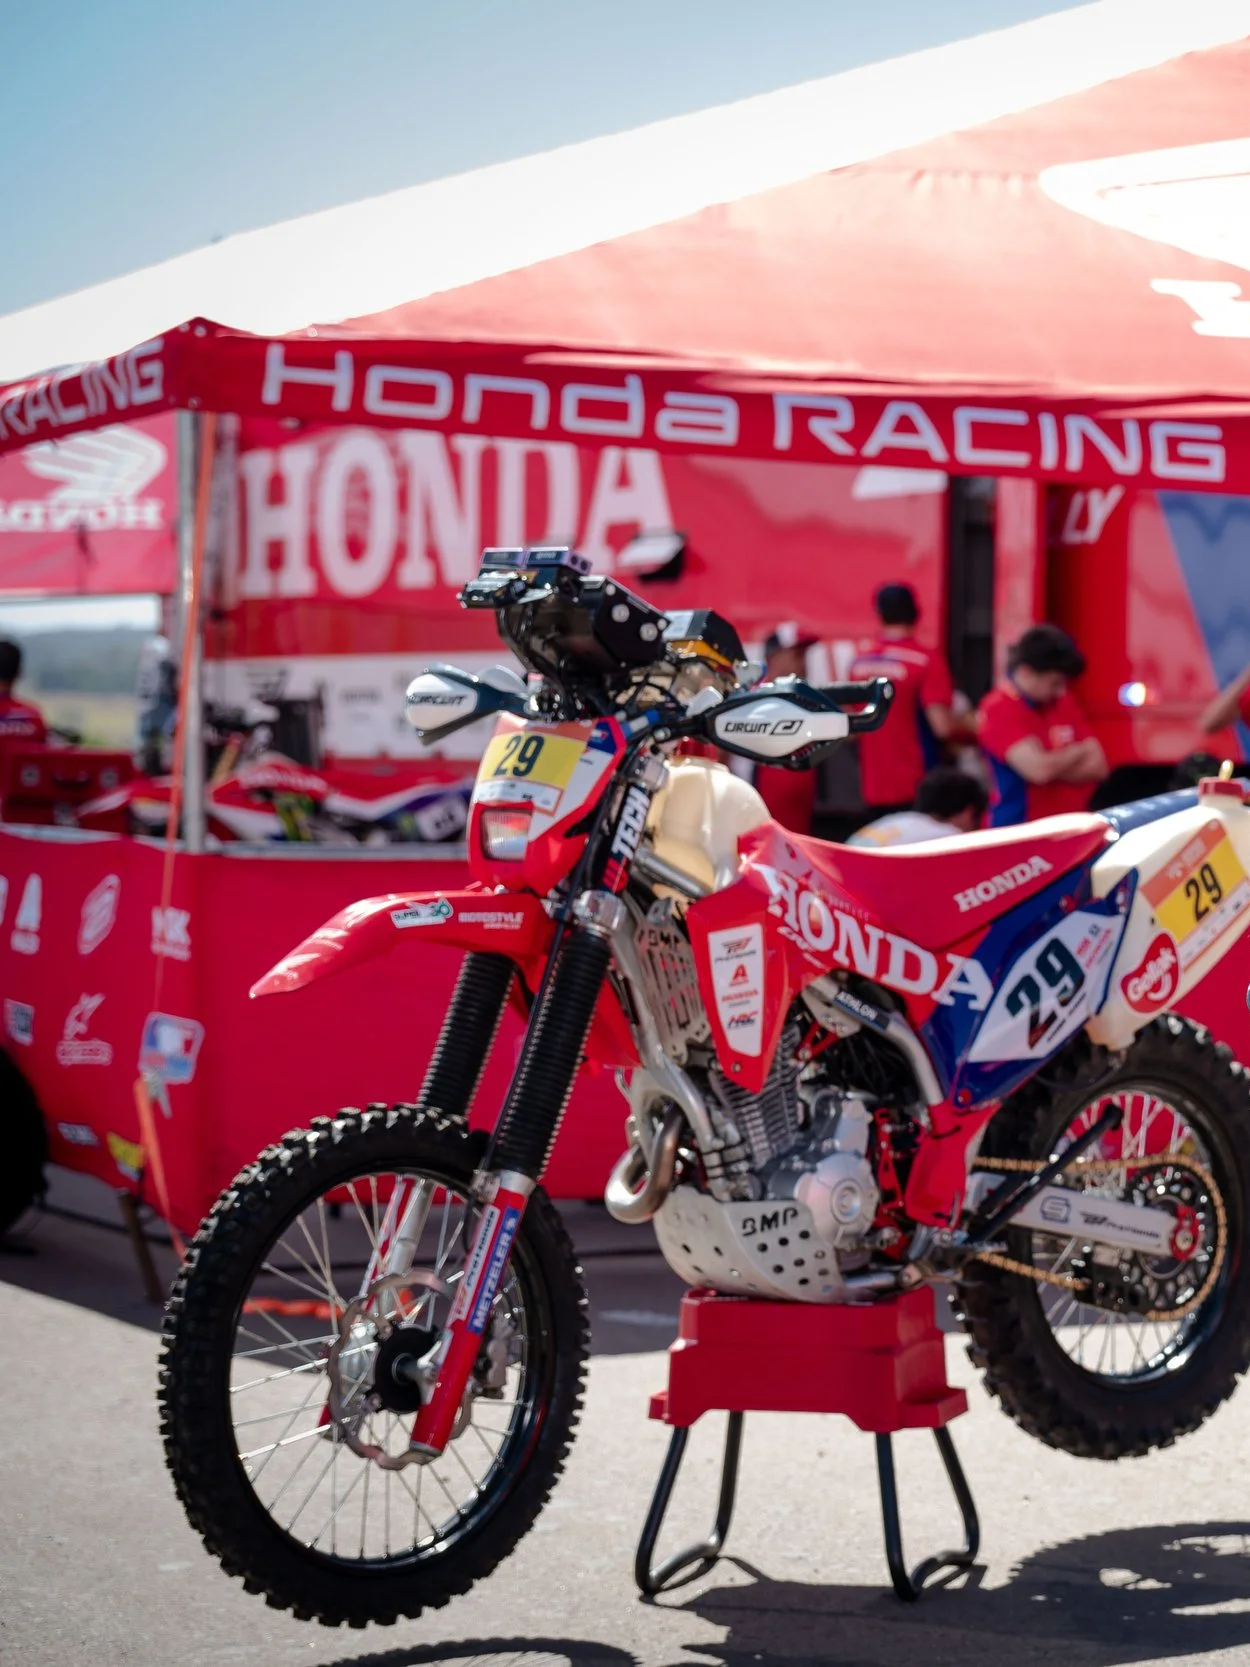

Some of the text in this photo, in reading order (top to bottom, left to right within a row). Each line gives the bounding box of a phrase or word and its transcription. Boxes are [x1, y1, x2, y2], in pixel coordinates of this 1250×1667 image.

[262, 342, 1227, 483] Honda RACING
[238, 427, 680, 599] HONDA
[493, 735, 545, 777] 29
[954, 856, 1053, 914] HONDA
[1184, 863, 1223, 923] 29
[756, 866, 994, 1012] HONDA
[1005, 937, 1086, 1050] 29
[742, 1207, 798, 1237] BMP
[473, 1233, 513, 1328] METZELER
